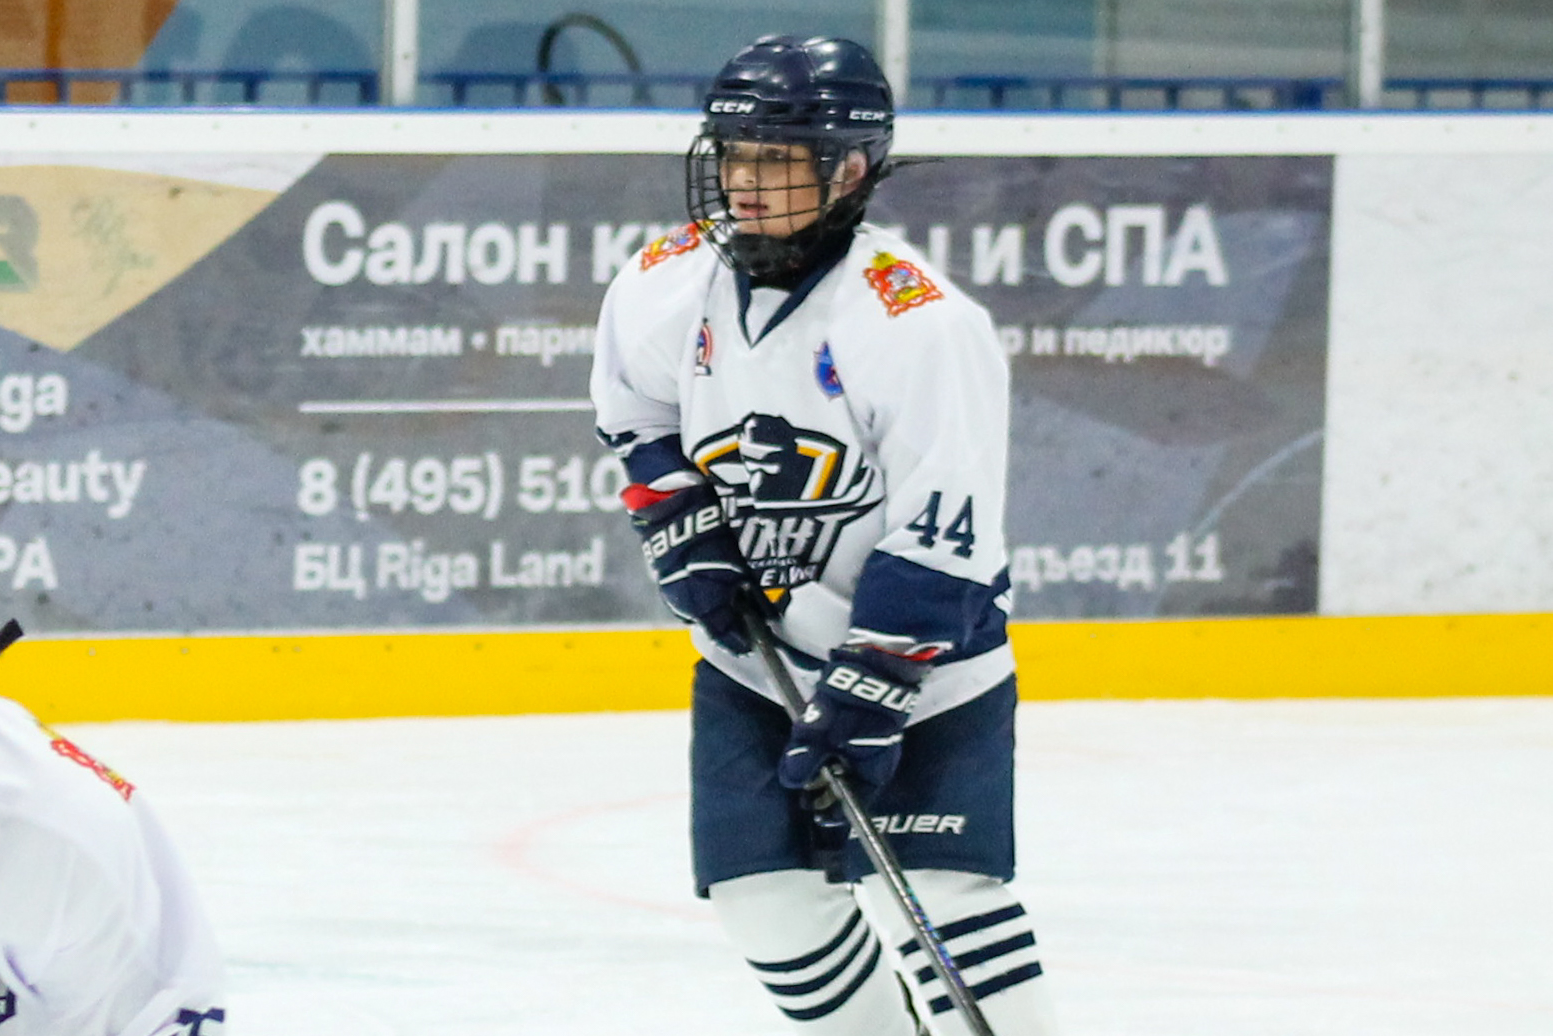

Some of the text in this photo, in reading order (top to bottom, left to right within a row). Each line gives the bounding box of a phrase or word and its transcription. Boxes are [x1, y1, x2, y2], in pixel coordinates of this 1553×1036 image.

[709, 100, 756, 114] CCM
[849, 109, 888, 122] CCM
[302, 202, 568, 287] Салон
[972, 224, 1021, 286] и
[1047, 204, 1230, 287] СПА
[299, 326, 462, 357] хаммам
[1031, 327, 1056, 354] и
[1064, 327, 1231, 367] педикюр
[297, 458, 338, 517] 8
[352, 453, 504, 520] (495)
[908, 491, 976, 559] 44
[293, 532, 1226, 601] БЦ Riga Land дъезд 11
